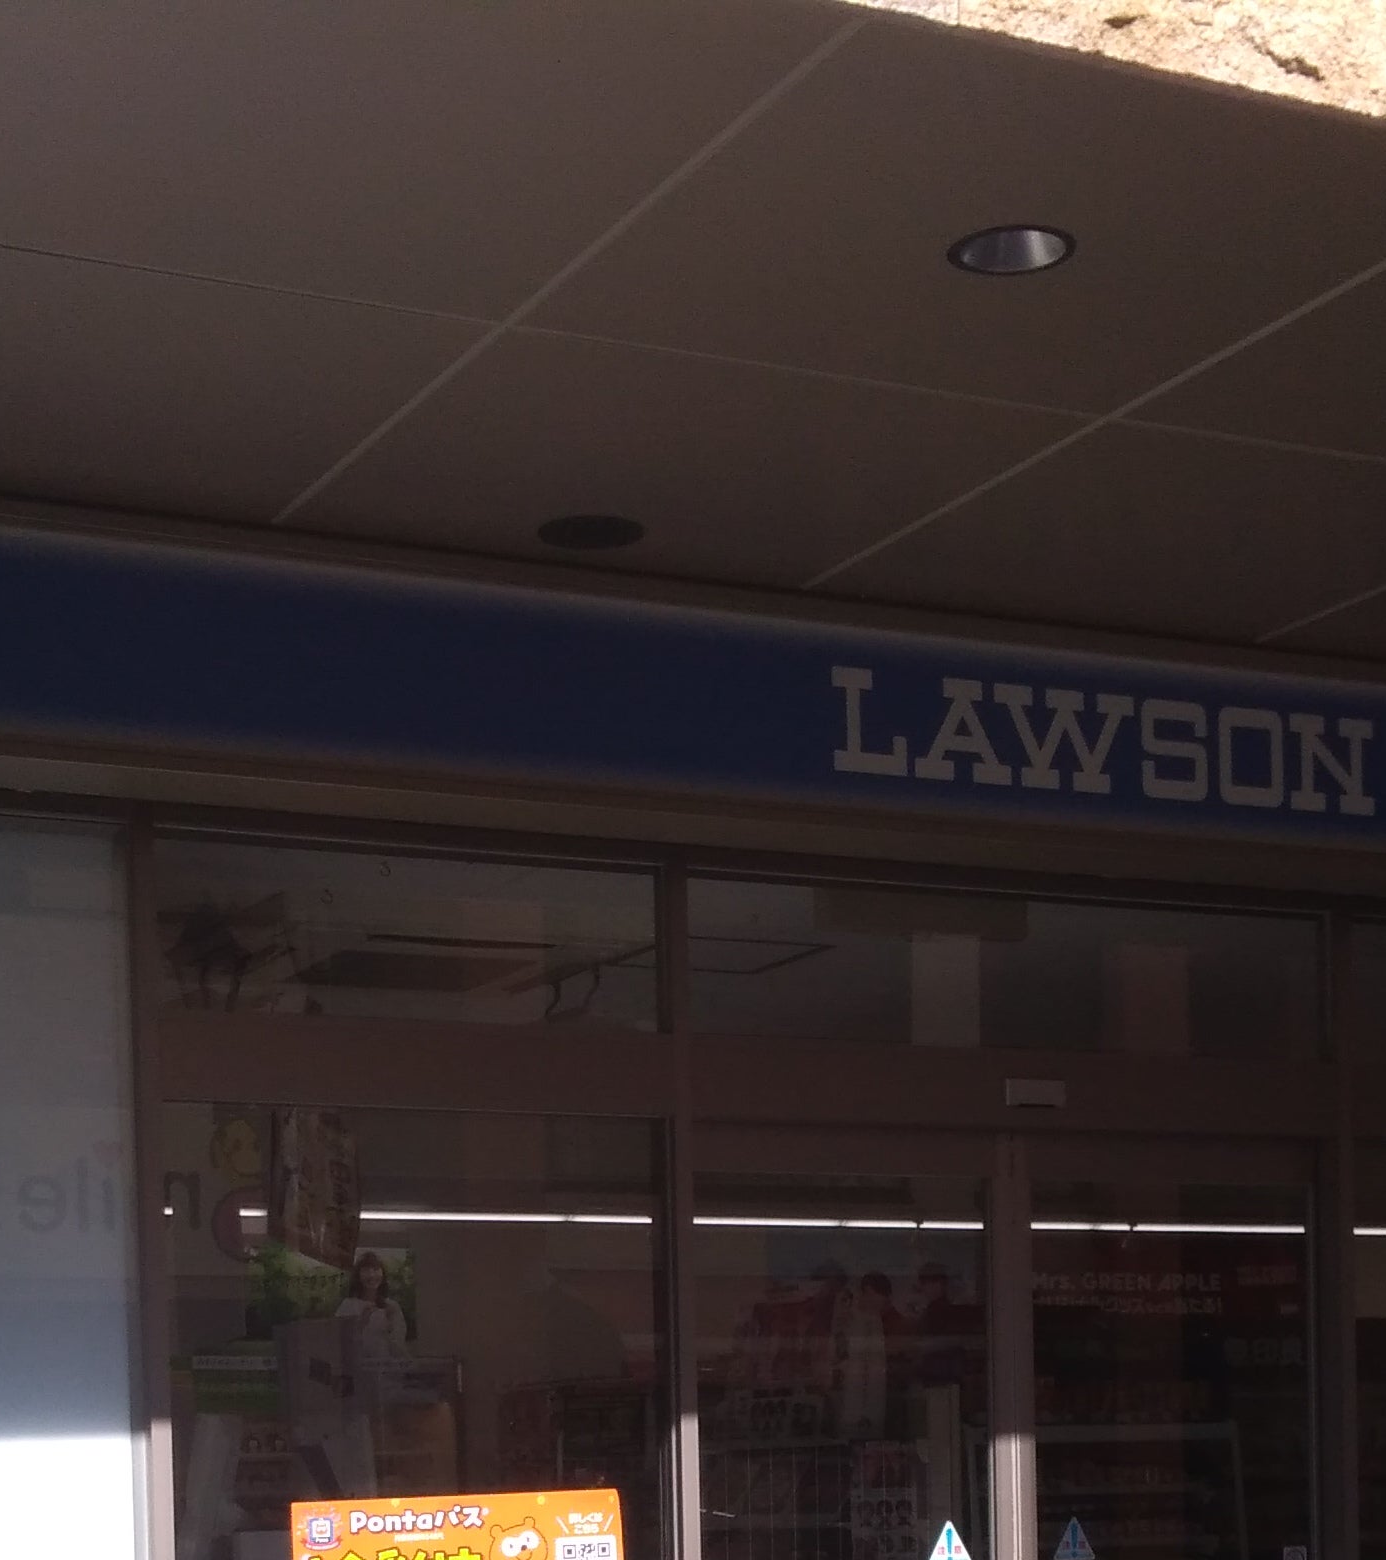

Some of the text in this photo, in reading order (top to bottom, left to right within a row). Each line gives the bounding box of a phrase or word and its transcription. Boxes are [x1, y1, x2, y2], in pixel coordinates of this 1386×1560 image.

[831, 667, 1376, 816] LAWSON
[1083, 1273, 1152, 1291] GREEN
[1157, 1273, 1222, 1291] APPLE
[349, 1505, 483, 1534] Pontaパス
